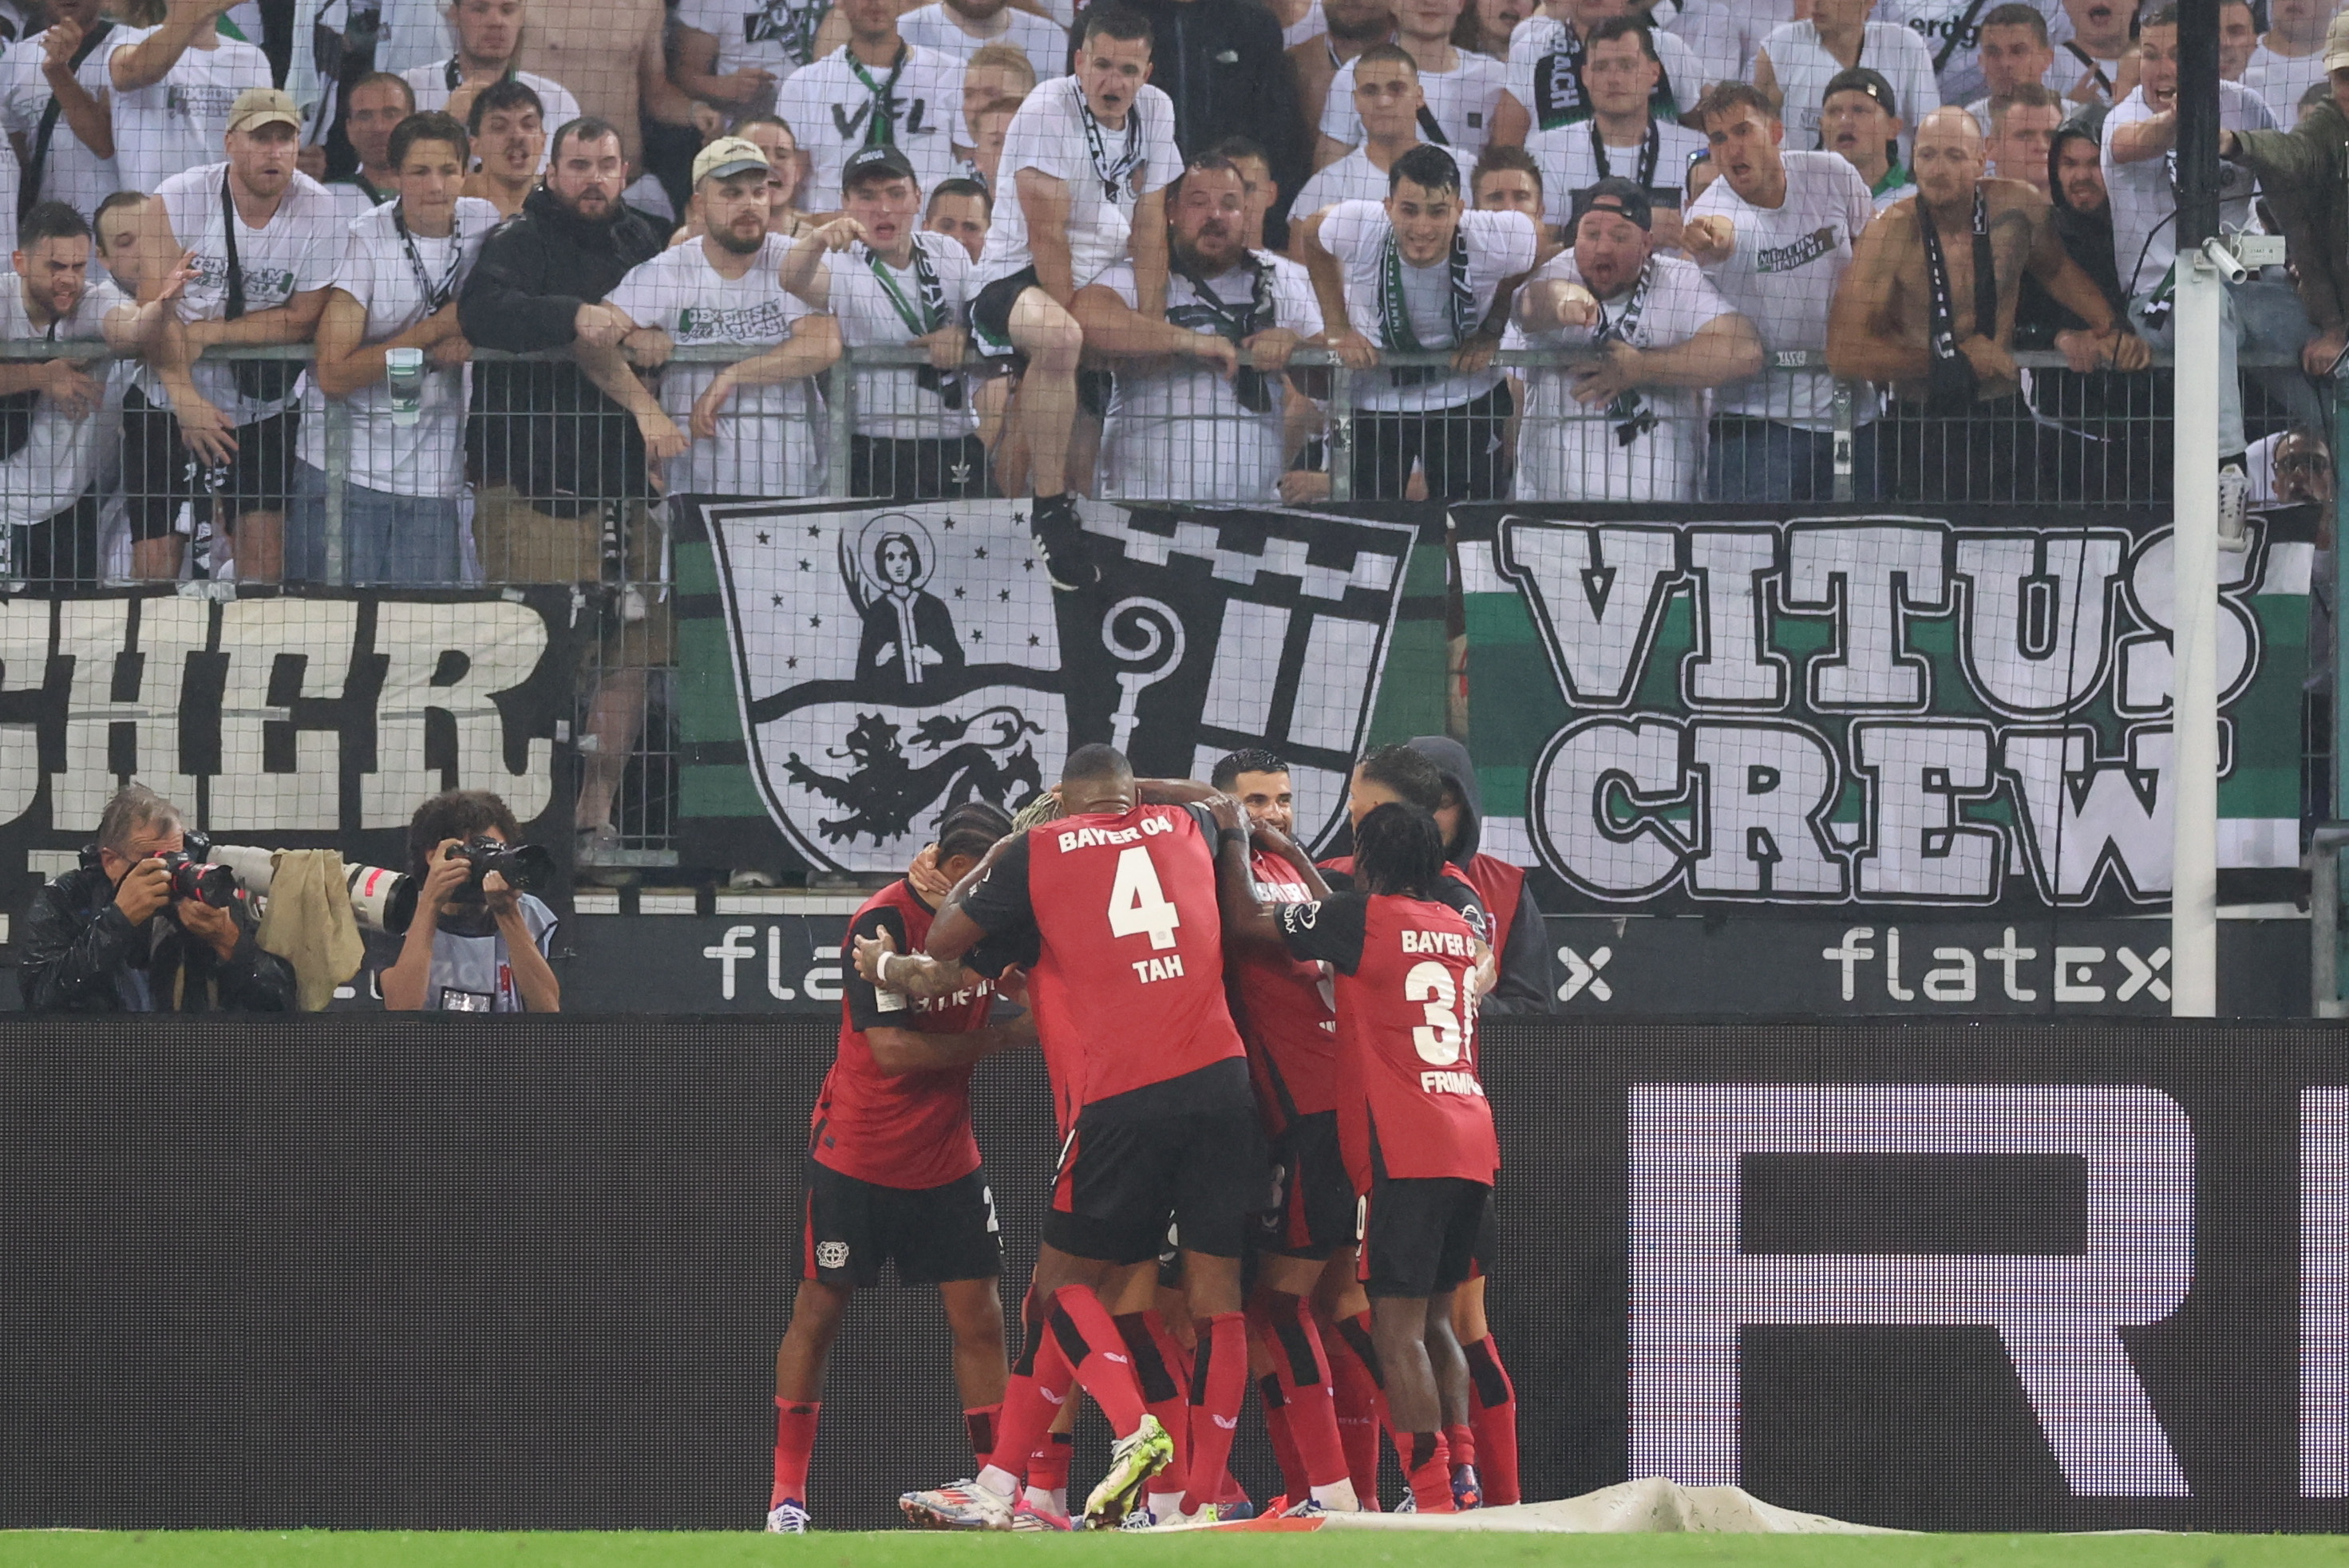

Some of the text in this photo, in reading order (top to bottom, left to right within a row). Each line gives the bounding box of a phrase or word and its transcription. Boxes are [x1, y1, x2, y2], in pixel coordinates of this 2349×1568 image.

[1501, 519, 2265, 718] VITUS
[1058, 816, 1173, 853] BAYER 04
[1531, 717, 2230, 905] CREW
[1108, 845, 1180, 950] 4
[703, 926, 843, 1001] fla
[1132, 954, 1184, 984] TAH
[1402, 930, 1465, 956] BAYER
